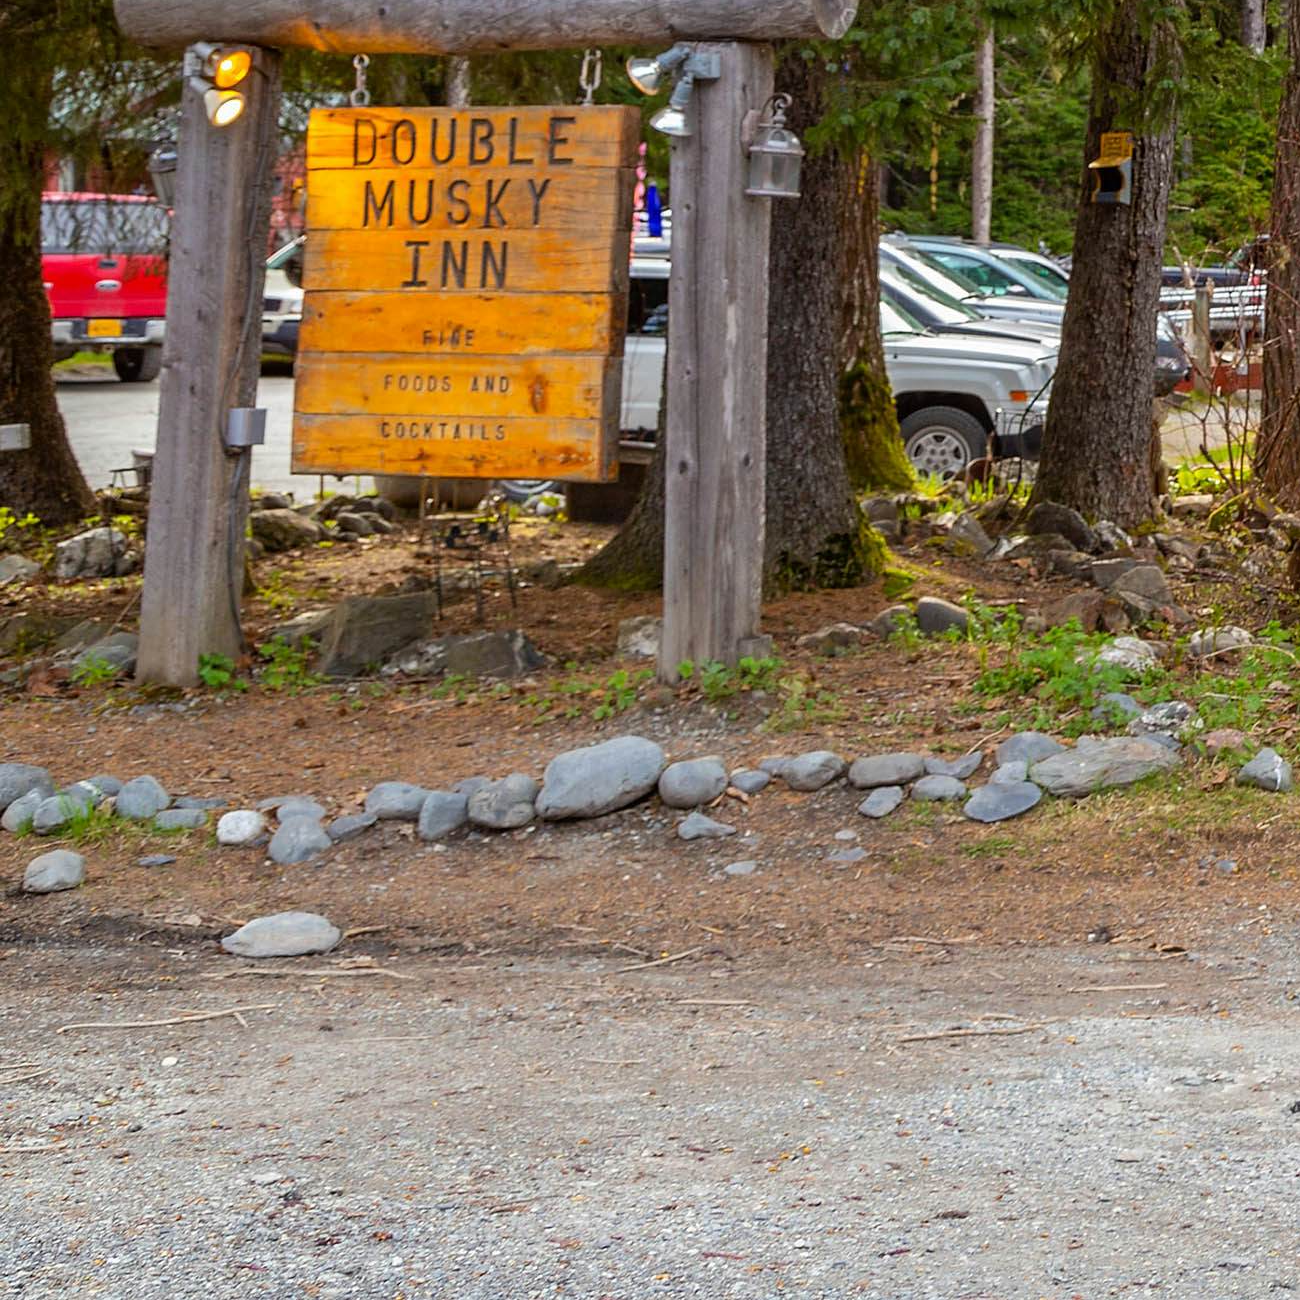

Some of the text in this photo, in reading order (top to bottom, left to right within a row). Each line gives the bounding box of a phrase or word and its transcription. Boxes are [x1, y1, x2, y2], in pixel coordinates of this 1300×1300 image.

[353, 116, 576, 167] DOUBLE
[363, 179, 551, 228] MUSKY
[402, 240, 508, 288] INN
[383, 374, 509, 393] FOODS AND
[380, 421, 505, 440] COCKTAILS
